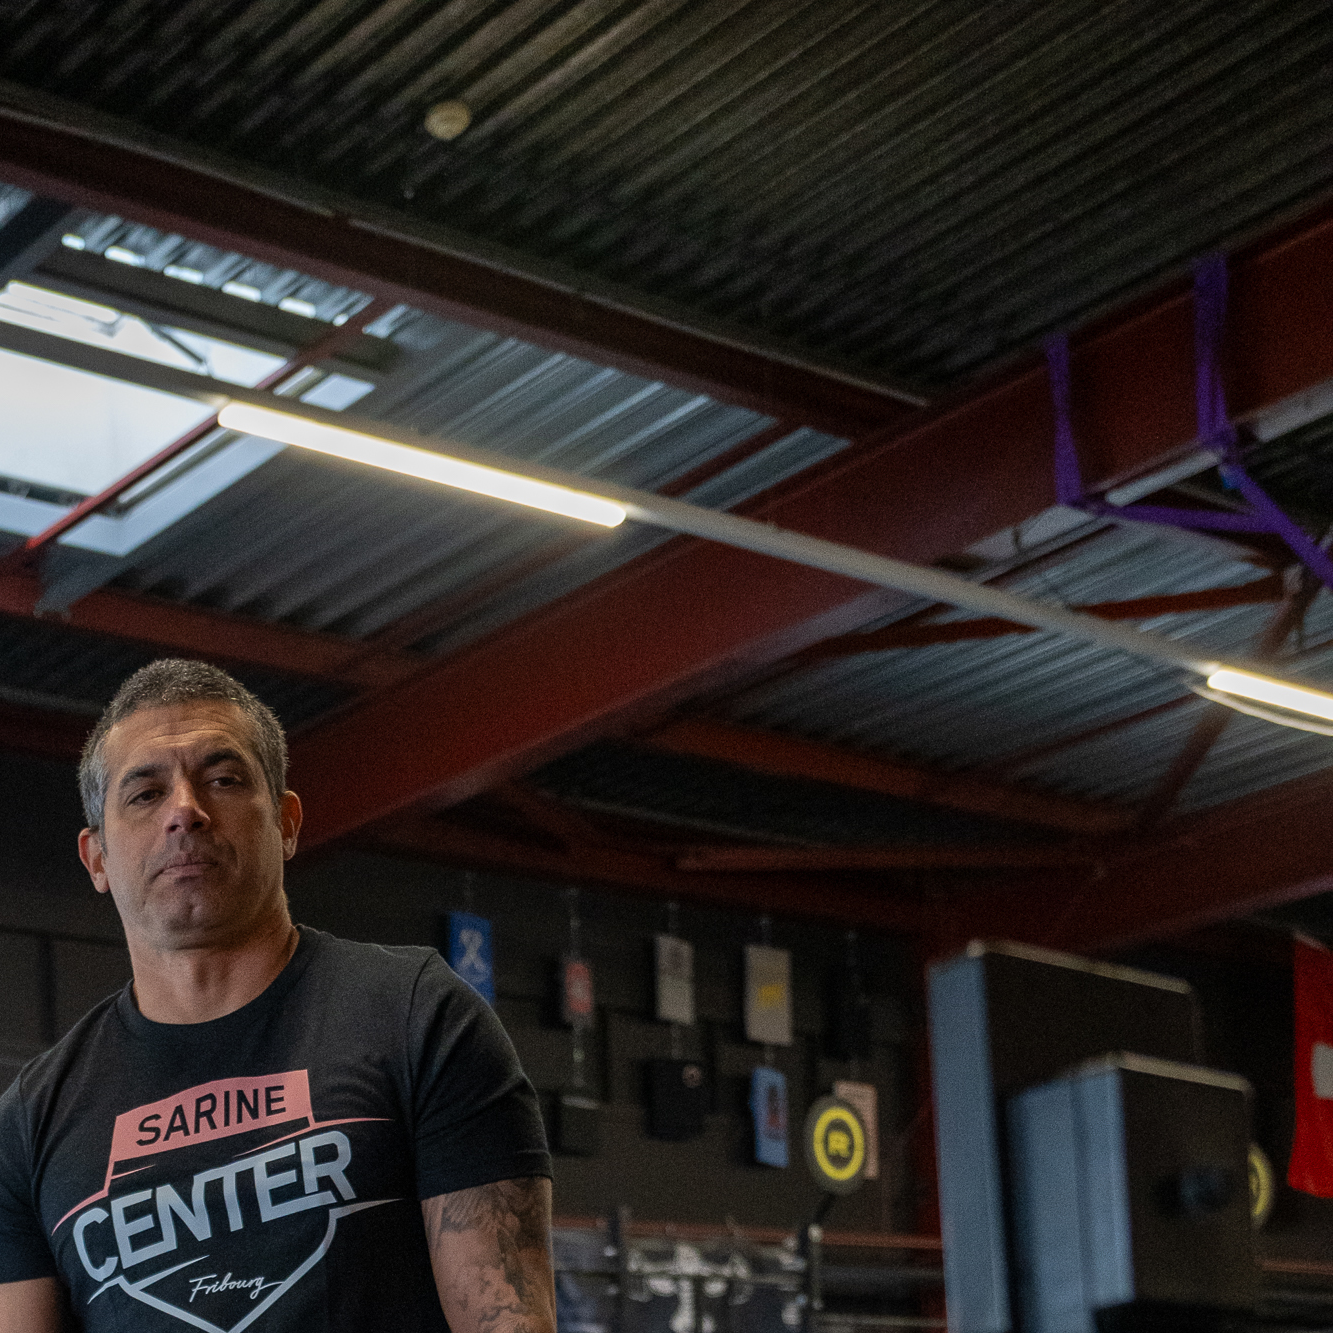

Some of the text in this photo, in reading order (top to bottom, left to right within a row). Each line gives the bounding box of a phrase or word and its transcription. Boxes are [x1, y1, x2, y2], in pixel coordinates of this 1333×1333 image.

[135, 1084, 287, 1147] SARINE
[72, 1129, 357, 1283] CENTER
[188, 1272, 269, 1304] Fribourg
